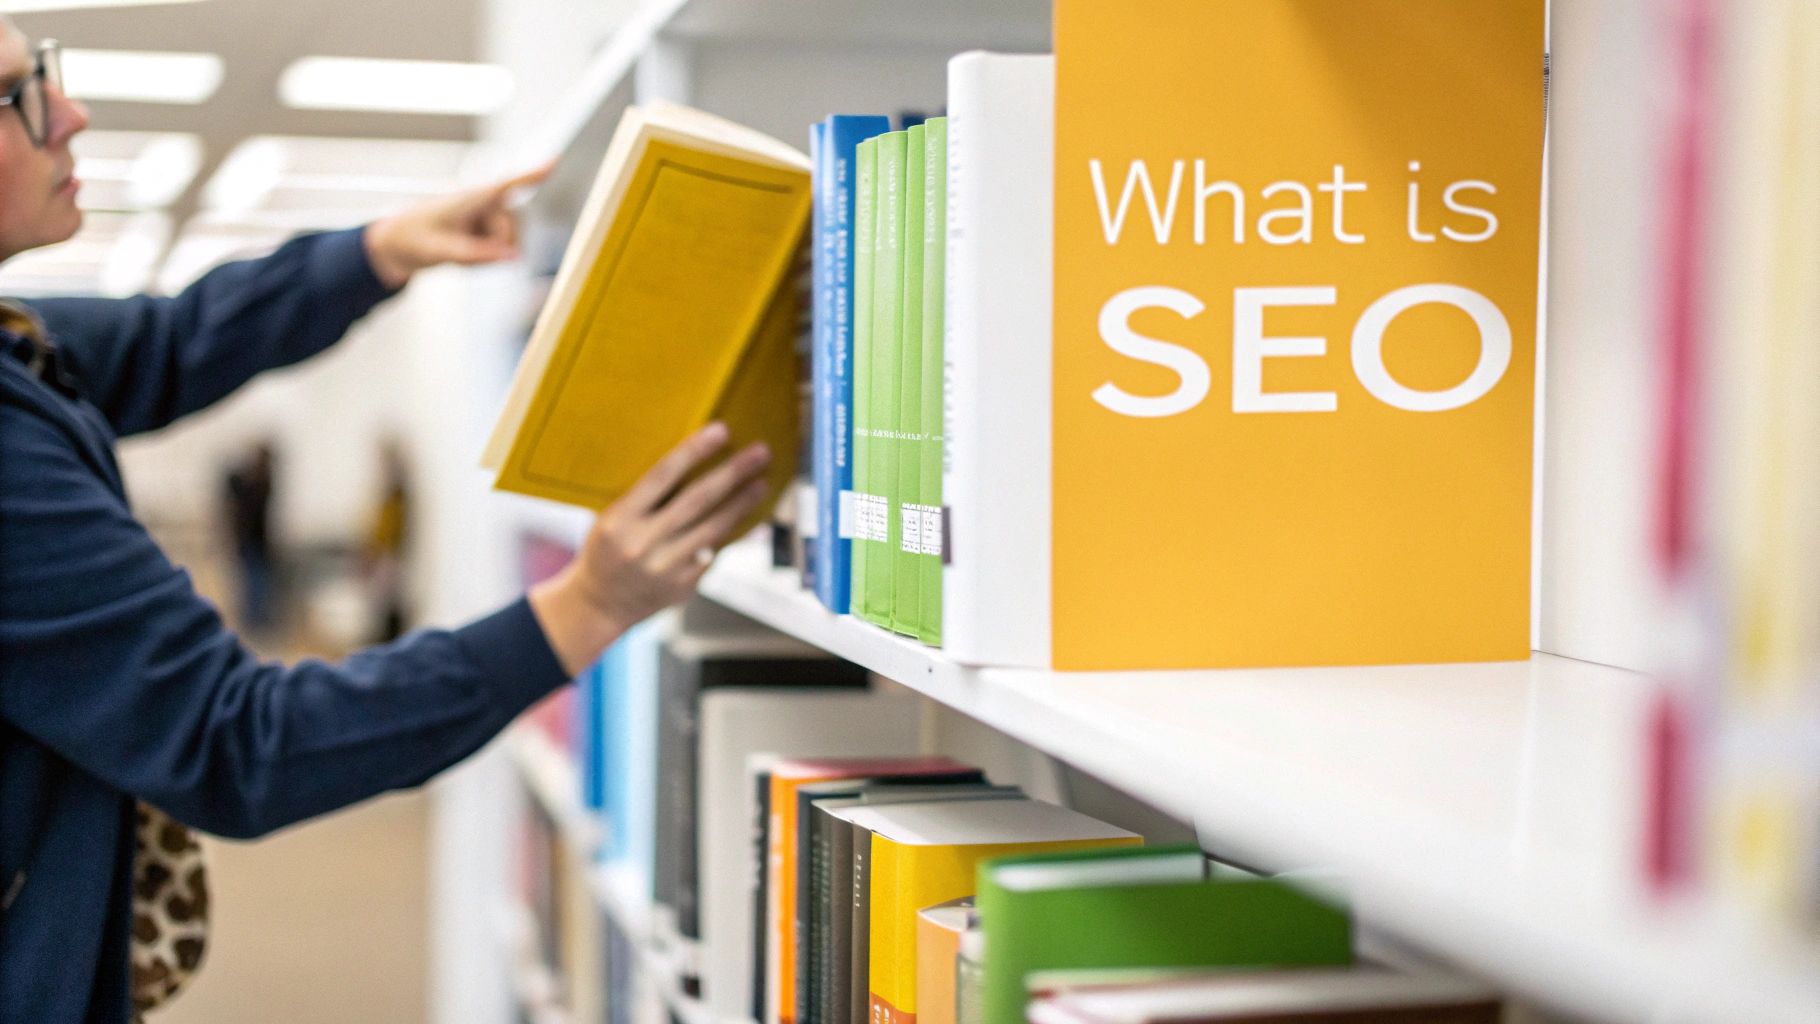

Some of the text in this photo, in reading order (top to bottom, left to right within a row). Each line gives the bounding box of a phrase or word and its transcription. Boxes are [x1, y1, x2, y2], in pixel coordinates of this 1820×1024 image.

[1089, 159, 1497, 245] What is
[1092, 284, 1511, 417] SEO
